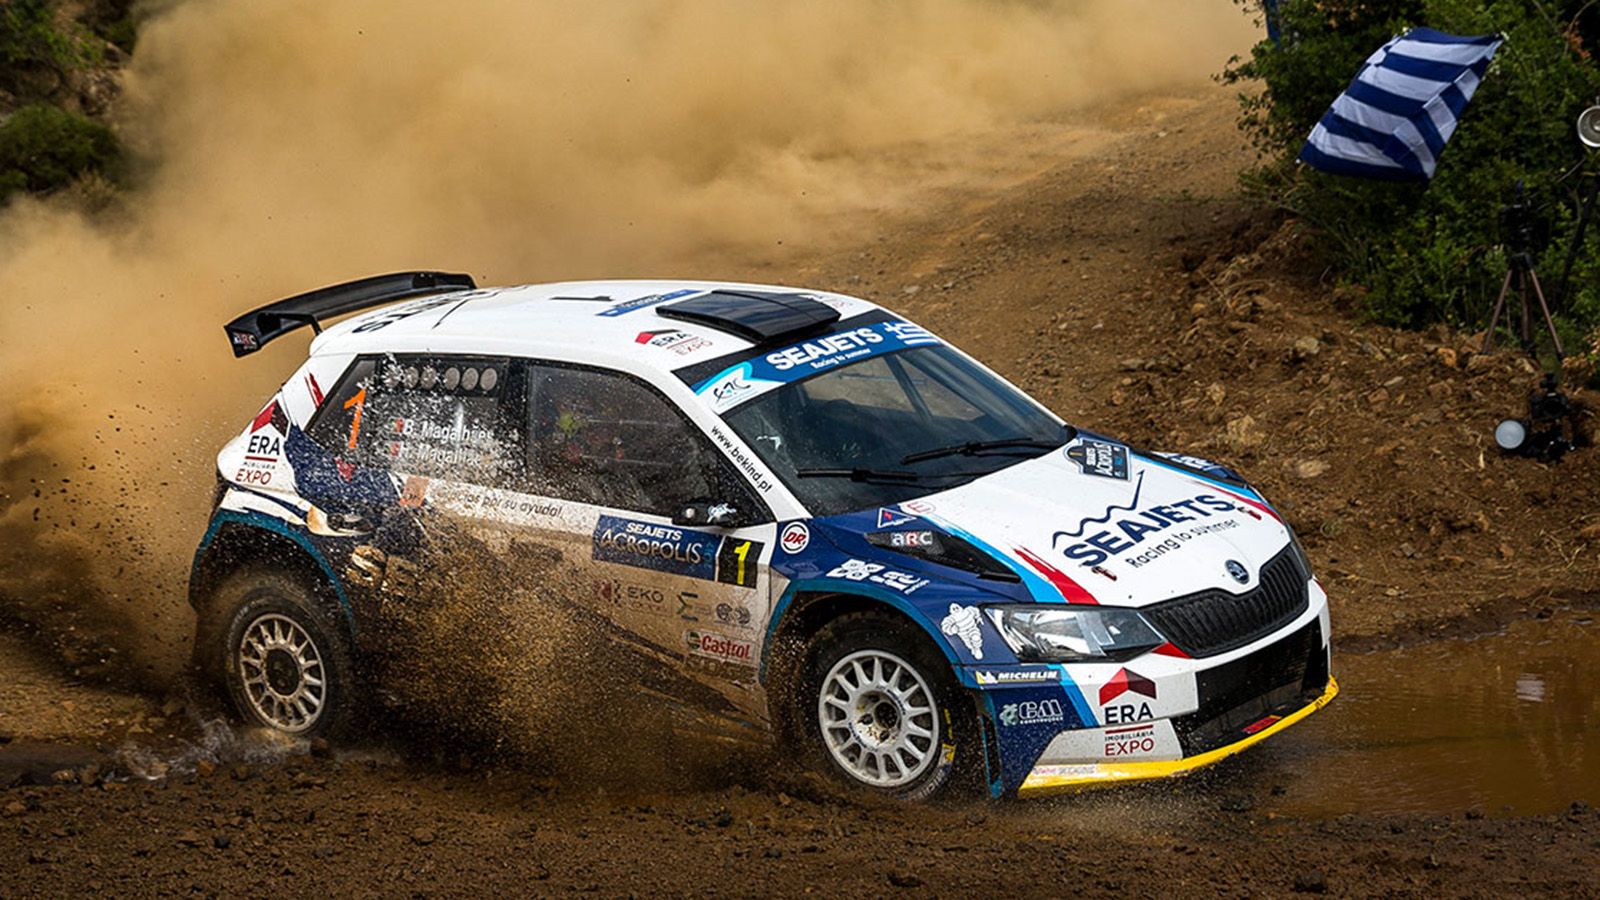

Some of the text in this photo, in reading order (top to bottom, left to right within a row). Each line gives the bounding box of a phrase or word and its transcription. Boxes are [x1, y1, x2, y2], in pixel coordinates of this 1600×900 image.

[766, 327, 884, 370] SEAJETS
[343, 388, 366, 449] 1
[247, 435, 280, 456] ERA
[711, 425, 773, 493] www.bekind.pt
[235, 469, 272, 485] EXPO
[504, 501, 517, 510] su
[519, 501, 563, 518] ayuda!
[626, 522, 683, 541] SEAJETS
[1063, 494, 1236, 567] SEAJETS
[600, 528, 703, 564] ACROPOLIS
[1125, 519, 1241, 568] Racing to summer
[734, 541, 752, 585] 1
[627, 586, 665, 604] EKO
[701, 635, 751, 660] Castrol
[997, 671, 1058, 680] MICHELIN
[1104, 702, 1153, 724] ERA
[1104, 738, 1154, 756] EXPO
